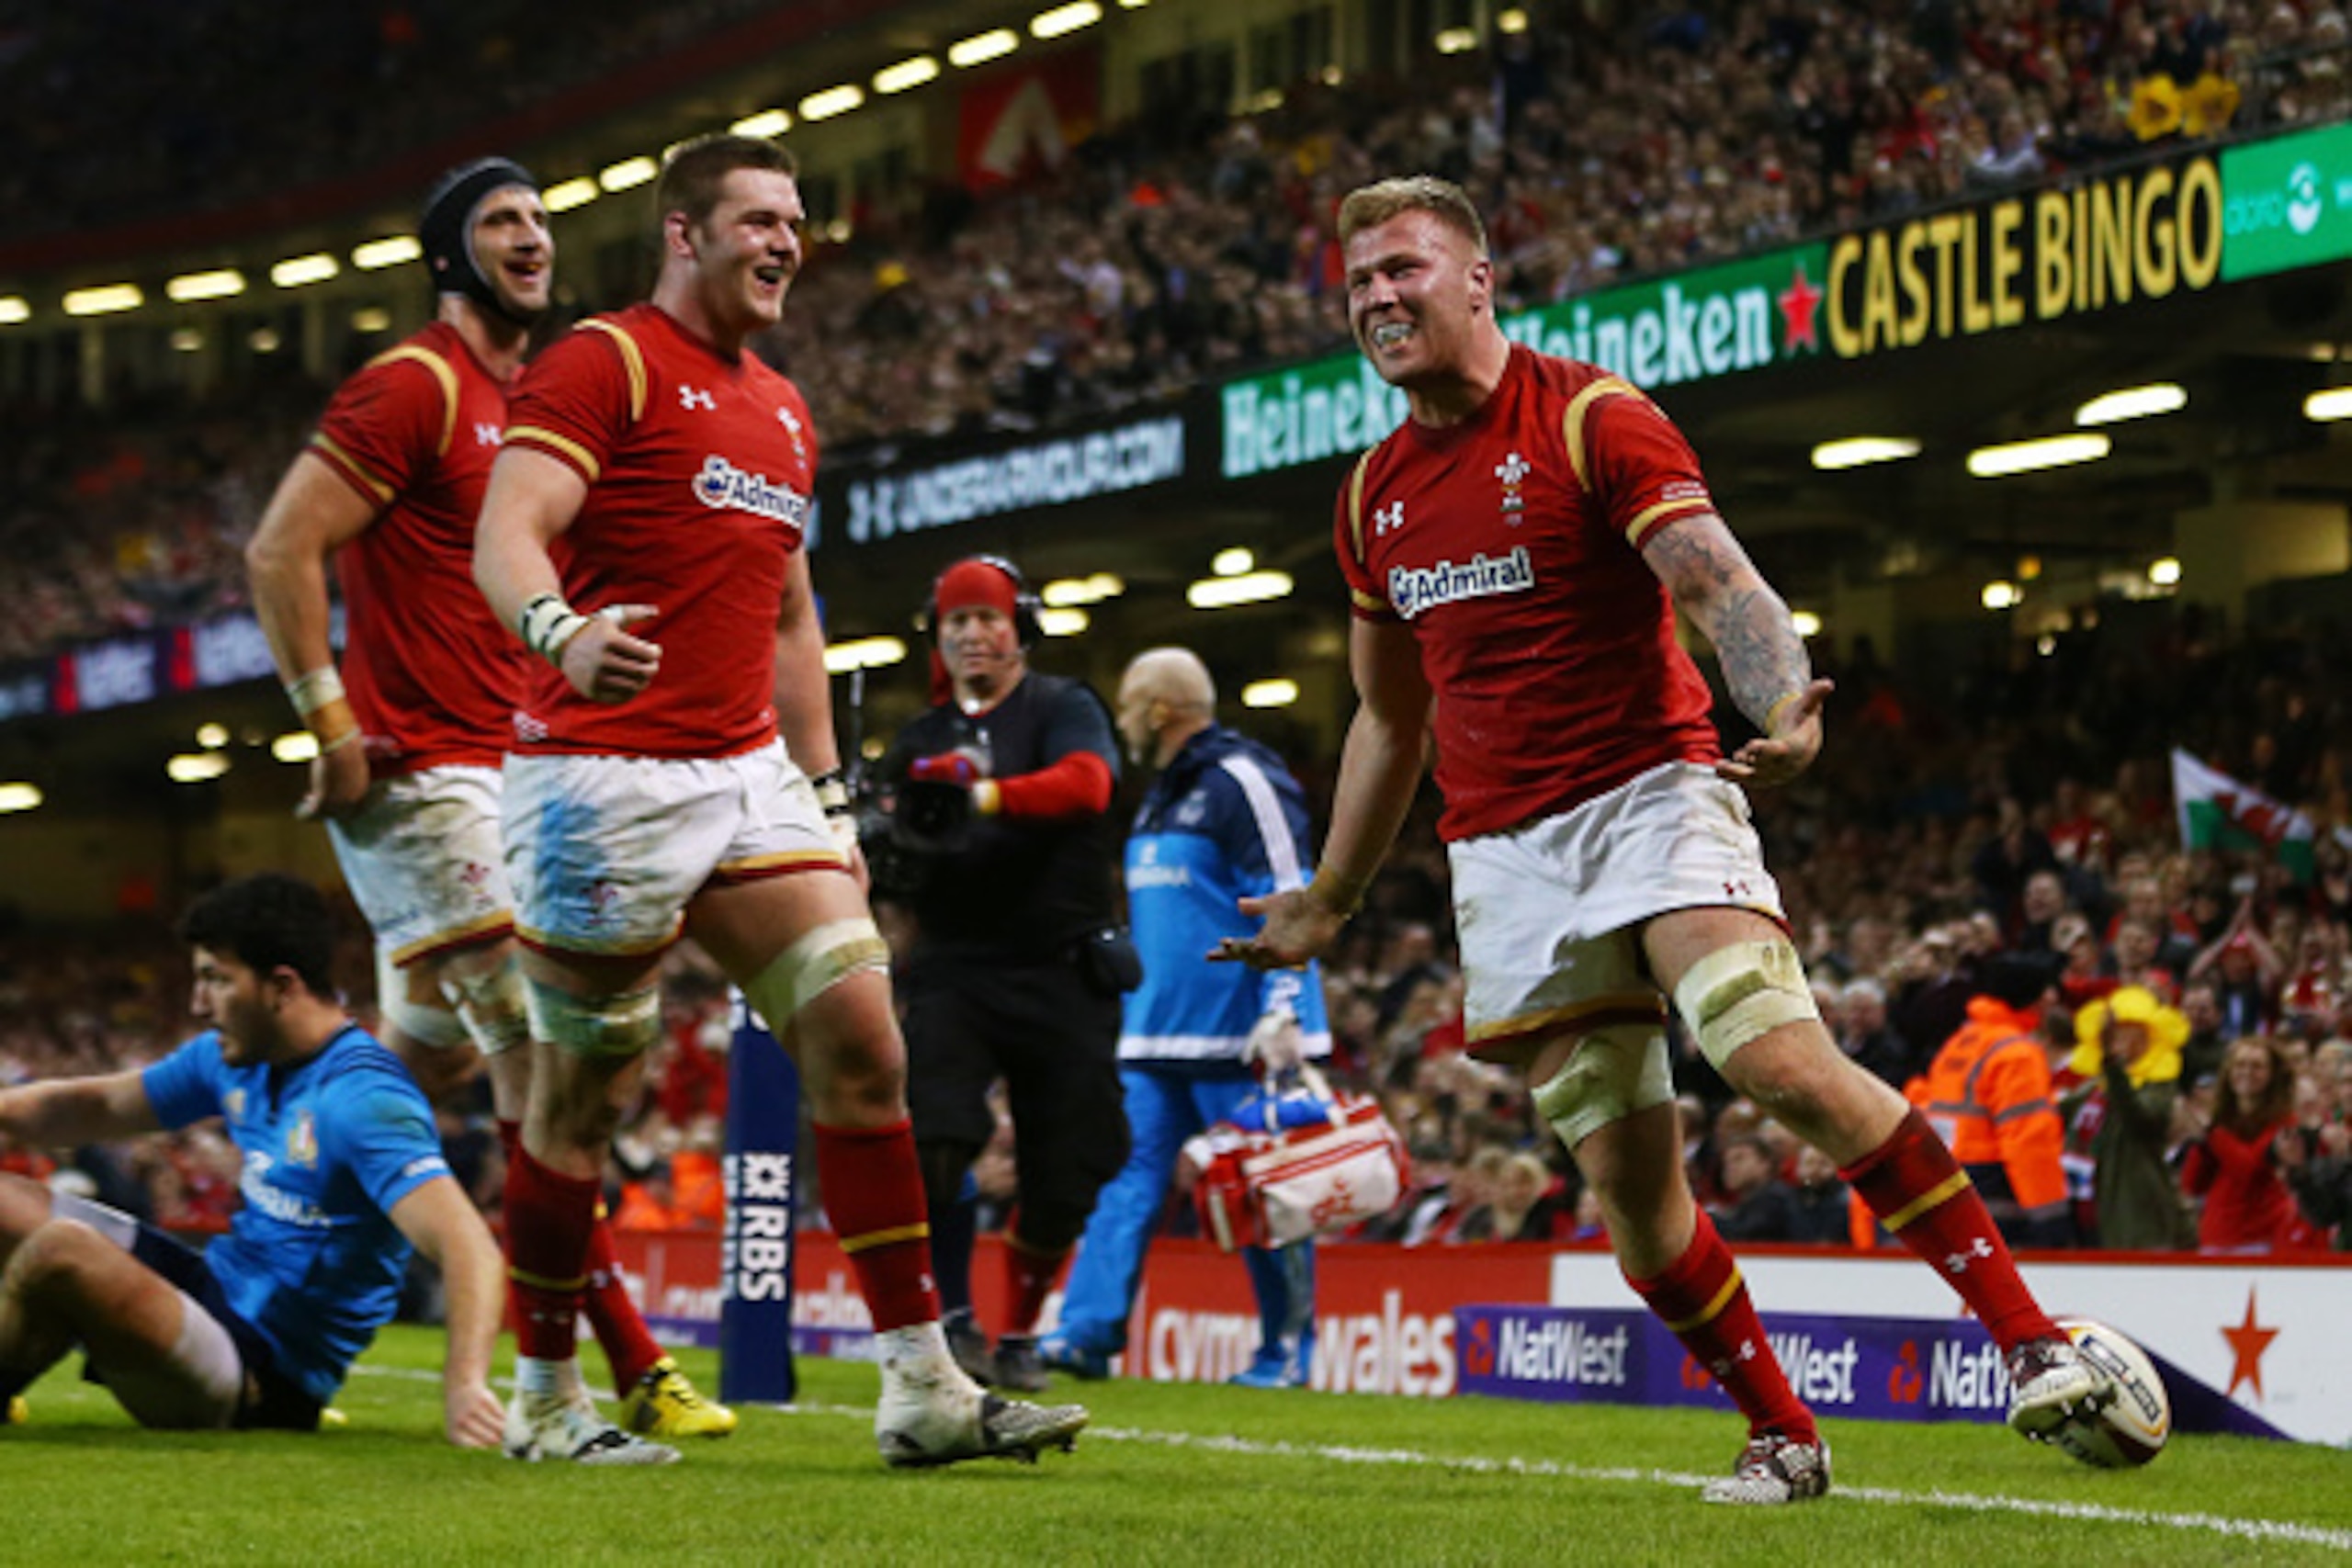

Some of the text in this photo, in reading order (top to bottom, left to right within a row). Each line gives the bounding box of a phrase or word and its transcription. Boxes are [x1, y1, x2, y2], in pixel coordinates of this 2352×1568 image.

[1827, 157, 2223, 359] CASTLE BINGO
[1506, 284, 1771, 388] ineken
[732, 473, 805, 524] Admira
[1416, 549, 1530, 607] Admiral
[738, 1204, 788, 1302] RBS
[1308, 1288, 1458, 1397] wales
[1498, 1316, 1629, 1386] NatWest
[1767, 1333, 1859, 1404] West
